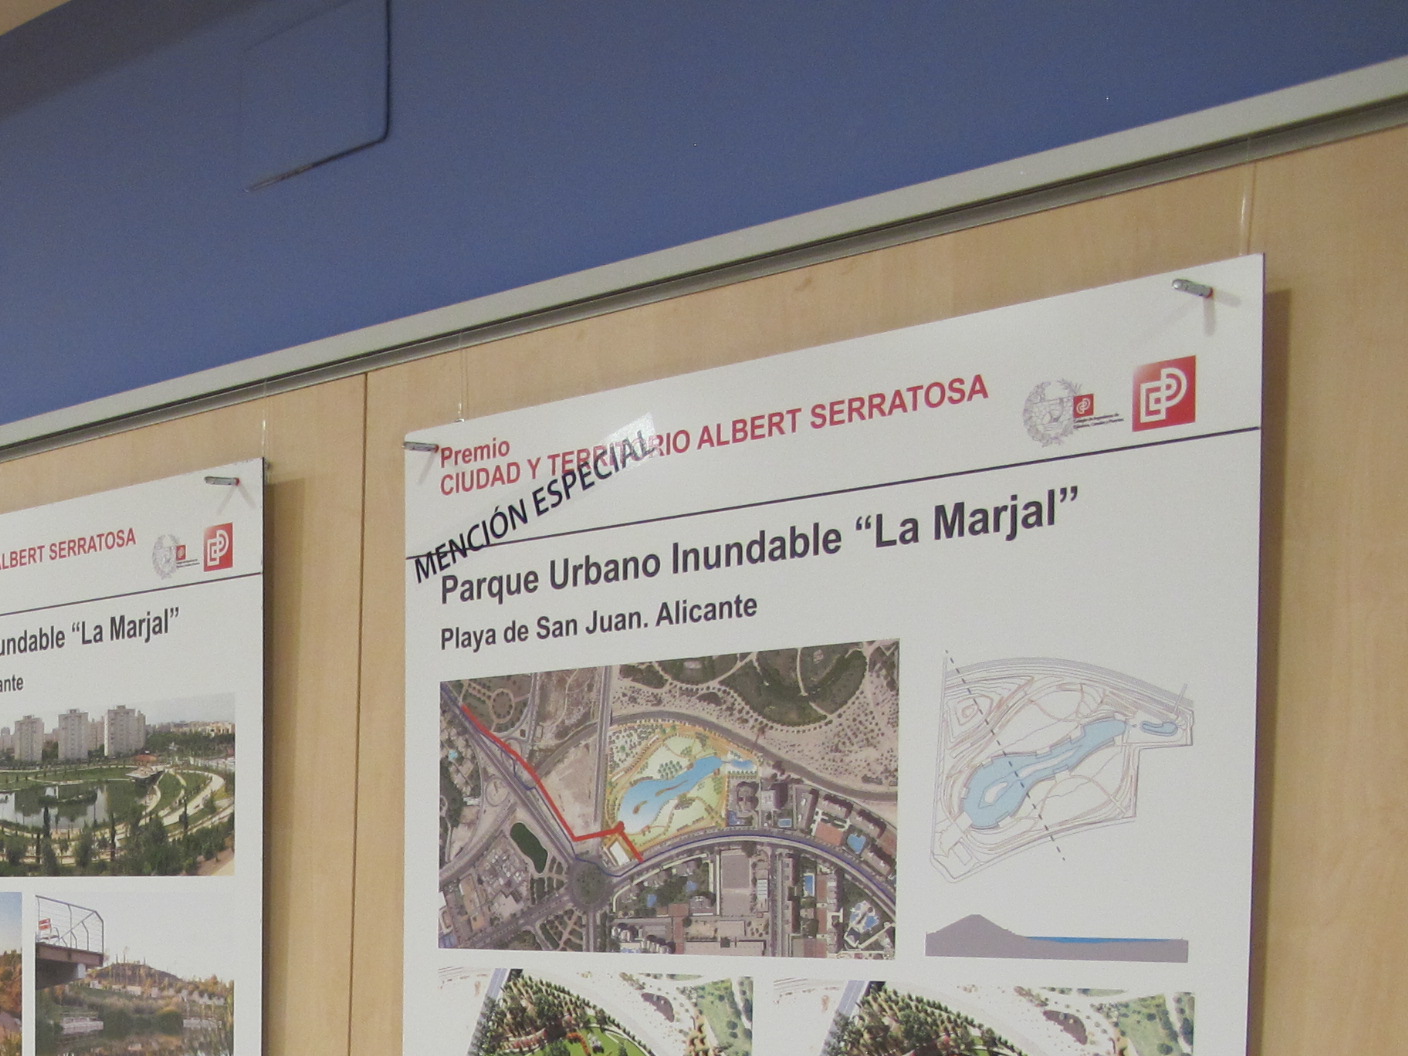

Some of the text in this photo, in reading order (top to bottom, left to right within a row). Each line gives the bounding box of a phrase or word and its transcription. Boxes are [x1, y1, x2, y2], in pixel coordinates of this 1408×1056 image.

[441, 374, 988, 495] CIUDAD Y TERRITORIO ALBERT SERRATOSA
[442, 438, 510, 468] Premio
[414, 430, 656, 583] MENCIÓN ESPECIAL
[49, 527, 137, 561] SERRATOSA
[442, 569, 539, 604] Parque
[550, 552, 660, 589] Urbano
[672, 518, 842, 574] Inundable
[442, 594, 758, 651] Playa de San Juan. Alicante
